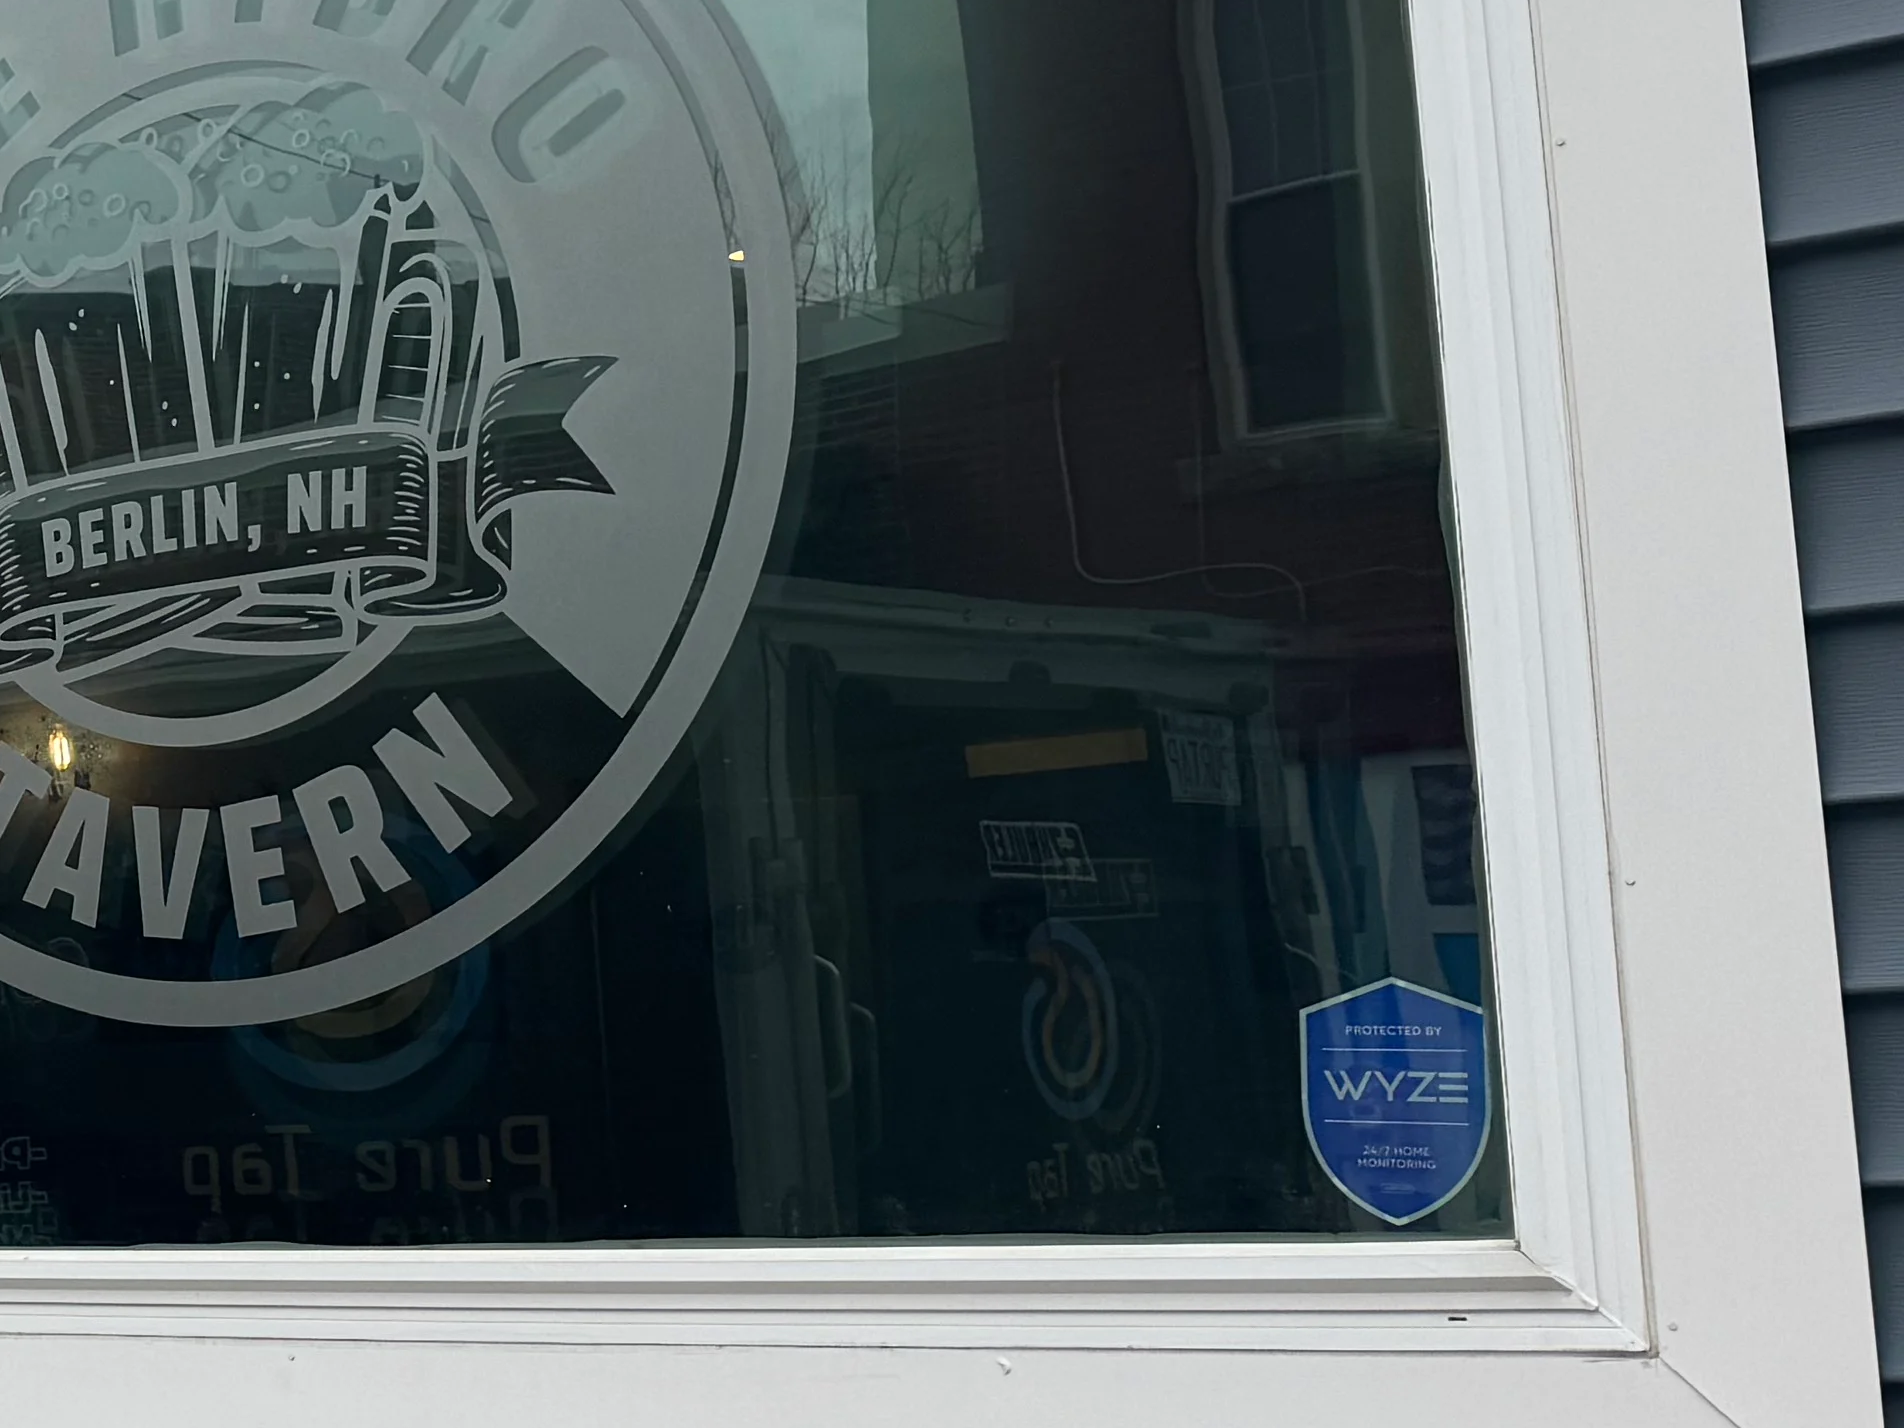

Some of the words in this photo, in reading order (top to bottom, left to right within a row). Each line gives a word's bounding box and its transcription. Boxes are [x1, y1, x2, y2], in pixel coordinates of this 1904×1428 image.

[40, 480, 262, 579] BERLIN,
[286, 465, 370, 537] NH
[1345, 1025, 1422, 1037] PROTECTED
[1425, 1025, 1442, 1037] BY
[1324, 1070, 1469, 1103] WYZE
[1394, 1146, 1431, 1157] HOME
[1357, 1158, 1437, 1170] MONITORING
